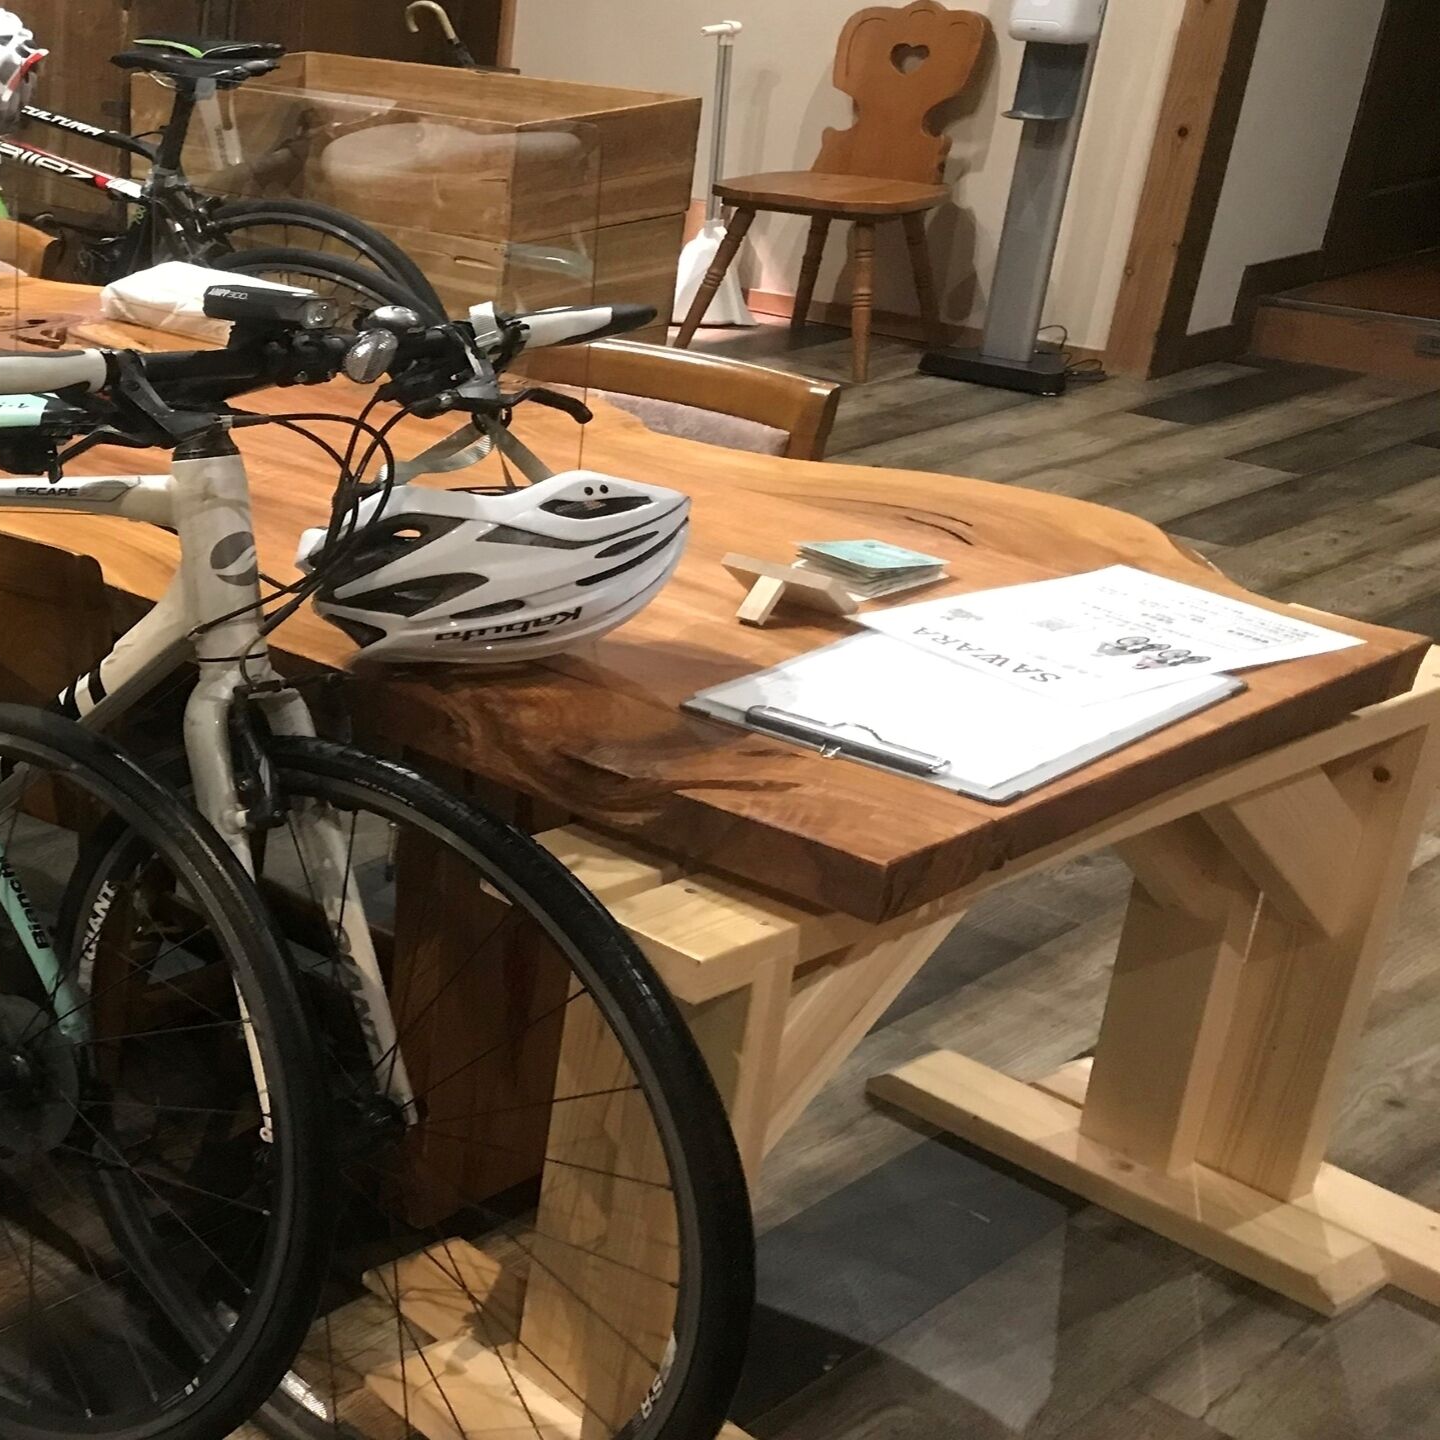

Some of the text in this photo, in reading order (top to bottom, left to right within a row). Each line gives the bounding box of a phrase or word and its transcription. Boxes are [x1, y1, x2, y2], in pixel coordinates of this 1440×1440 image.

[16, 487, 79, 497] ESCAPE
[434, 606, 583, 642] Kabuto
[913, 627, 1061, 683] SAWARA
[82, 880, 116, 961] GIANT
